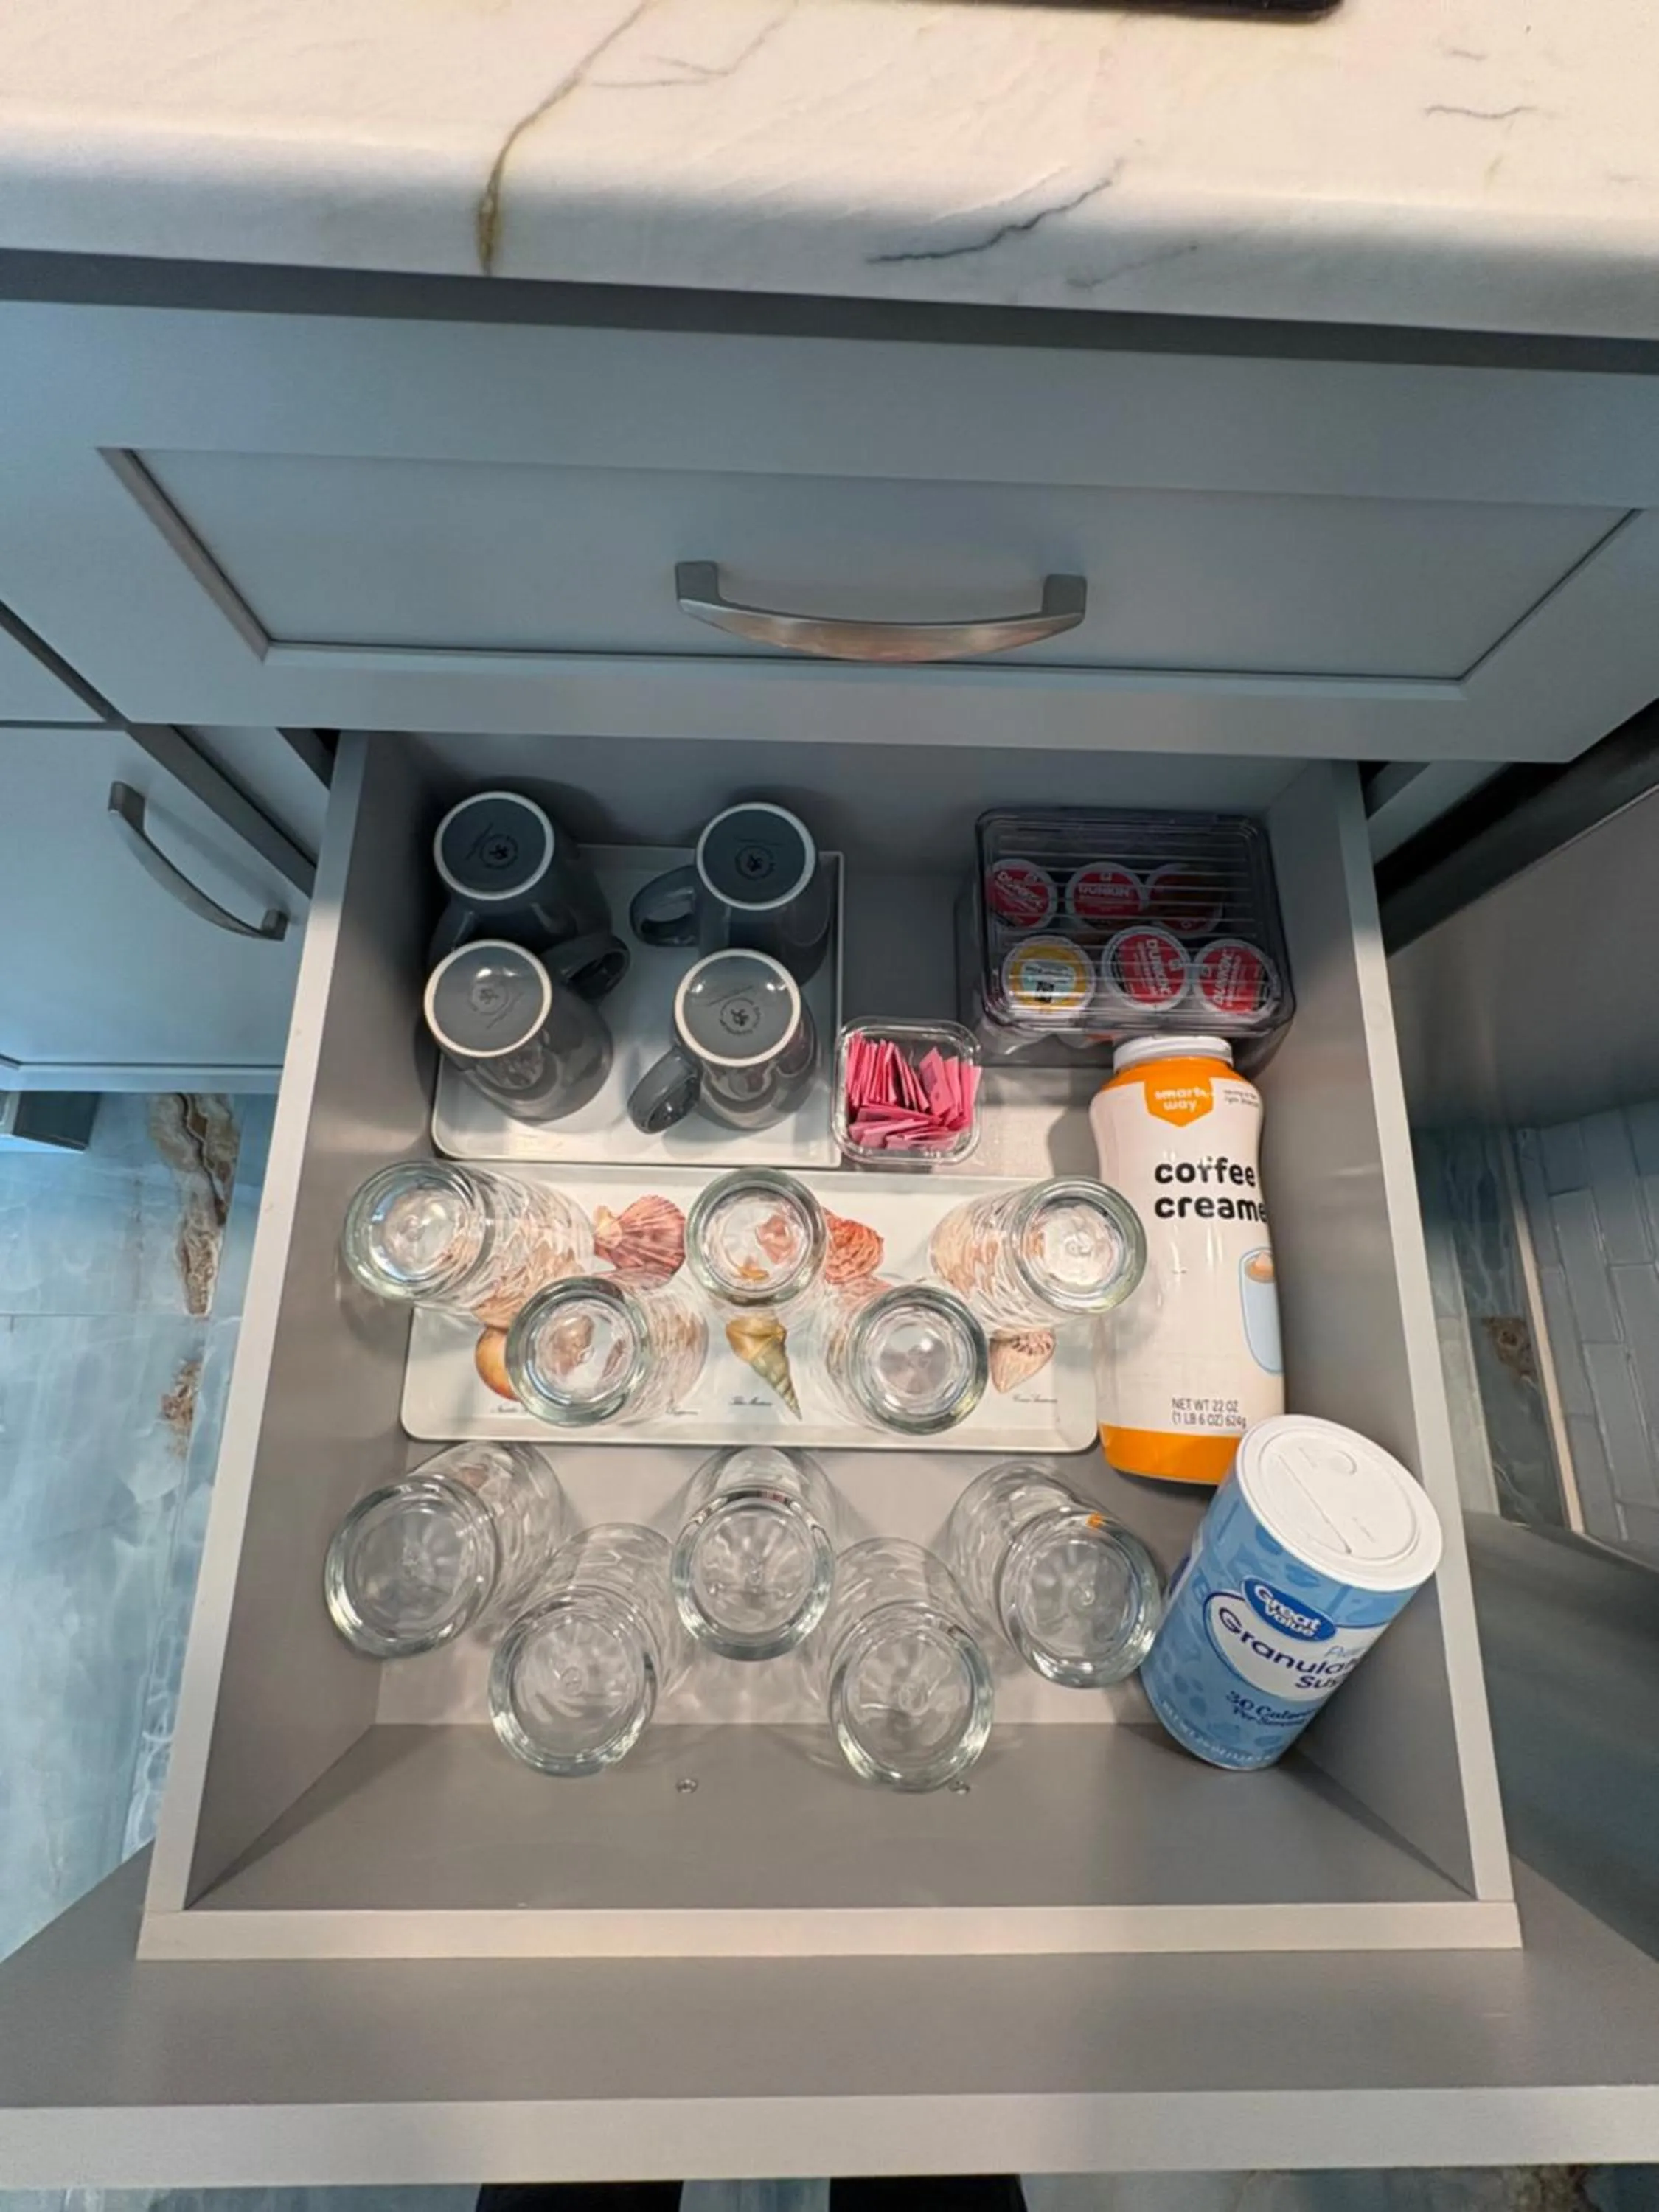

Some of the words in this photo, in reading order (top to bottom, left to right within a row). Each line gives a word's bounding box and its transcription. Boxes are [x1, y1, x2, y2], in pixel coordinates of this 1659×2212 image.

[1154, 1085, 1208, 1099] smart
[1163, 1099, 1197, 1113] way
[1154, 1155, 1256, 1188] coffee
[1154, 1197, 1268, 1224] creame
[1172, 1397, 1192, 1411] NET
[1194, 1399, 1209, 1411] WT
[1212, 1400, 1224, 1412] 22
[1225, 1400, 1239, 1413] OZ
[1183, 1412, 1196, 1425] LB
[1199, 1413, 1206, 1425] 6
[1255, 1585, 1321, 1631] Great
[1265, 1603, 1316, 1637] Value
